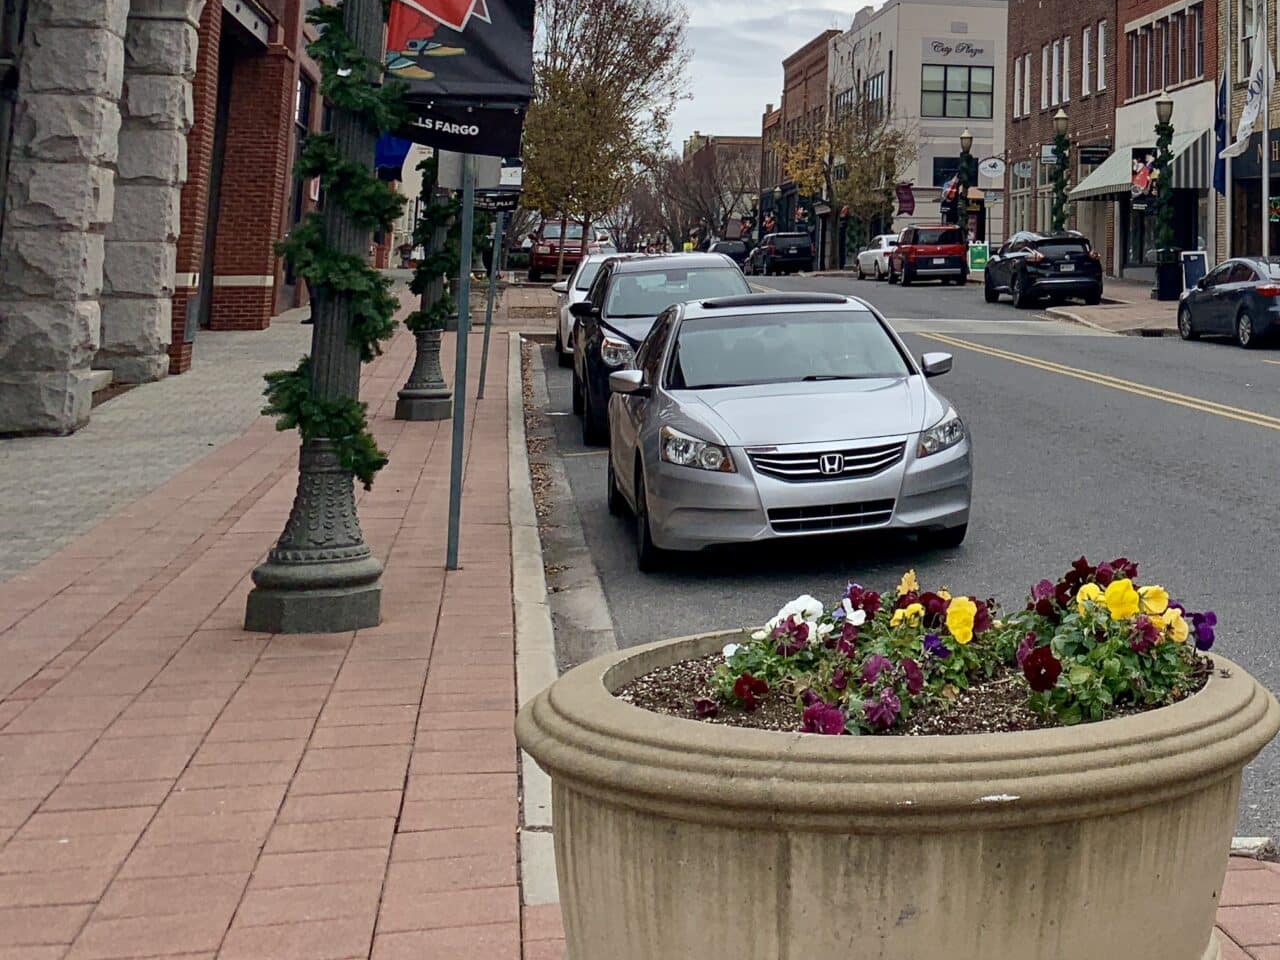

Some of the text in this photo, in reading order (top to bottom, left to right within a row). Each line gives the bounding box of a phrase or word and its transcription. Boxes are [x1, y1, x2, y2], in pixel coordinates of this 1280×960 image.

[931, 41, 984, 58] City Plaza
[435, 120, 479, 136] FARGO
